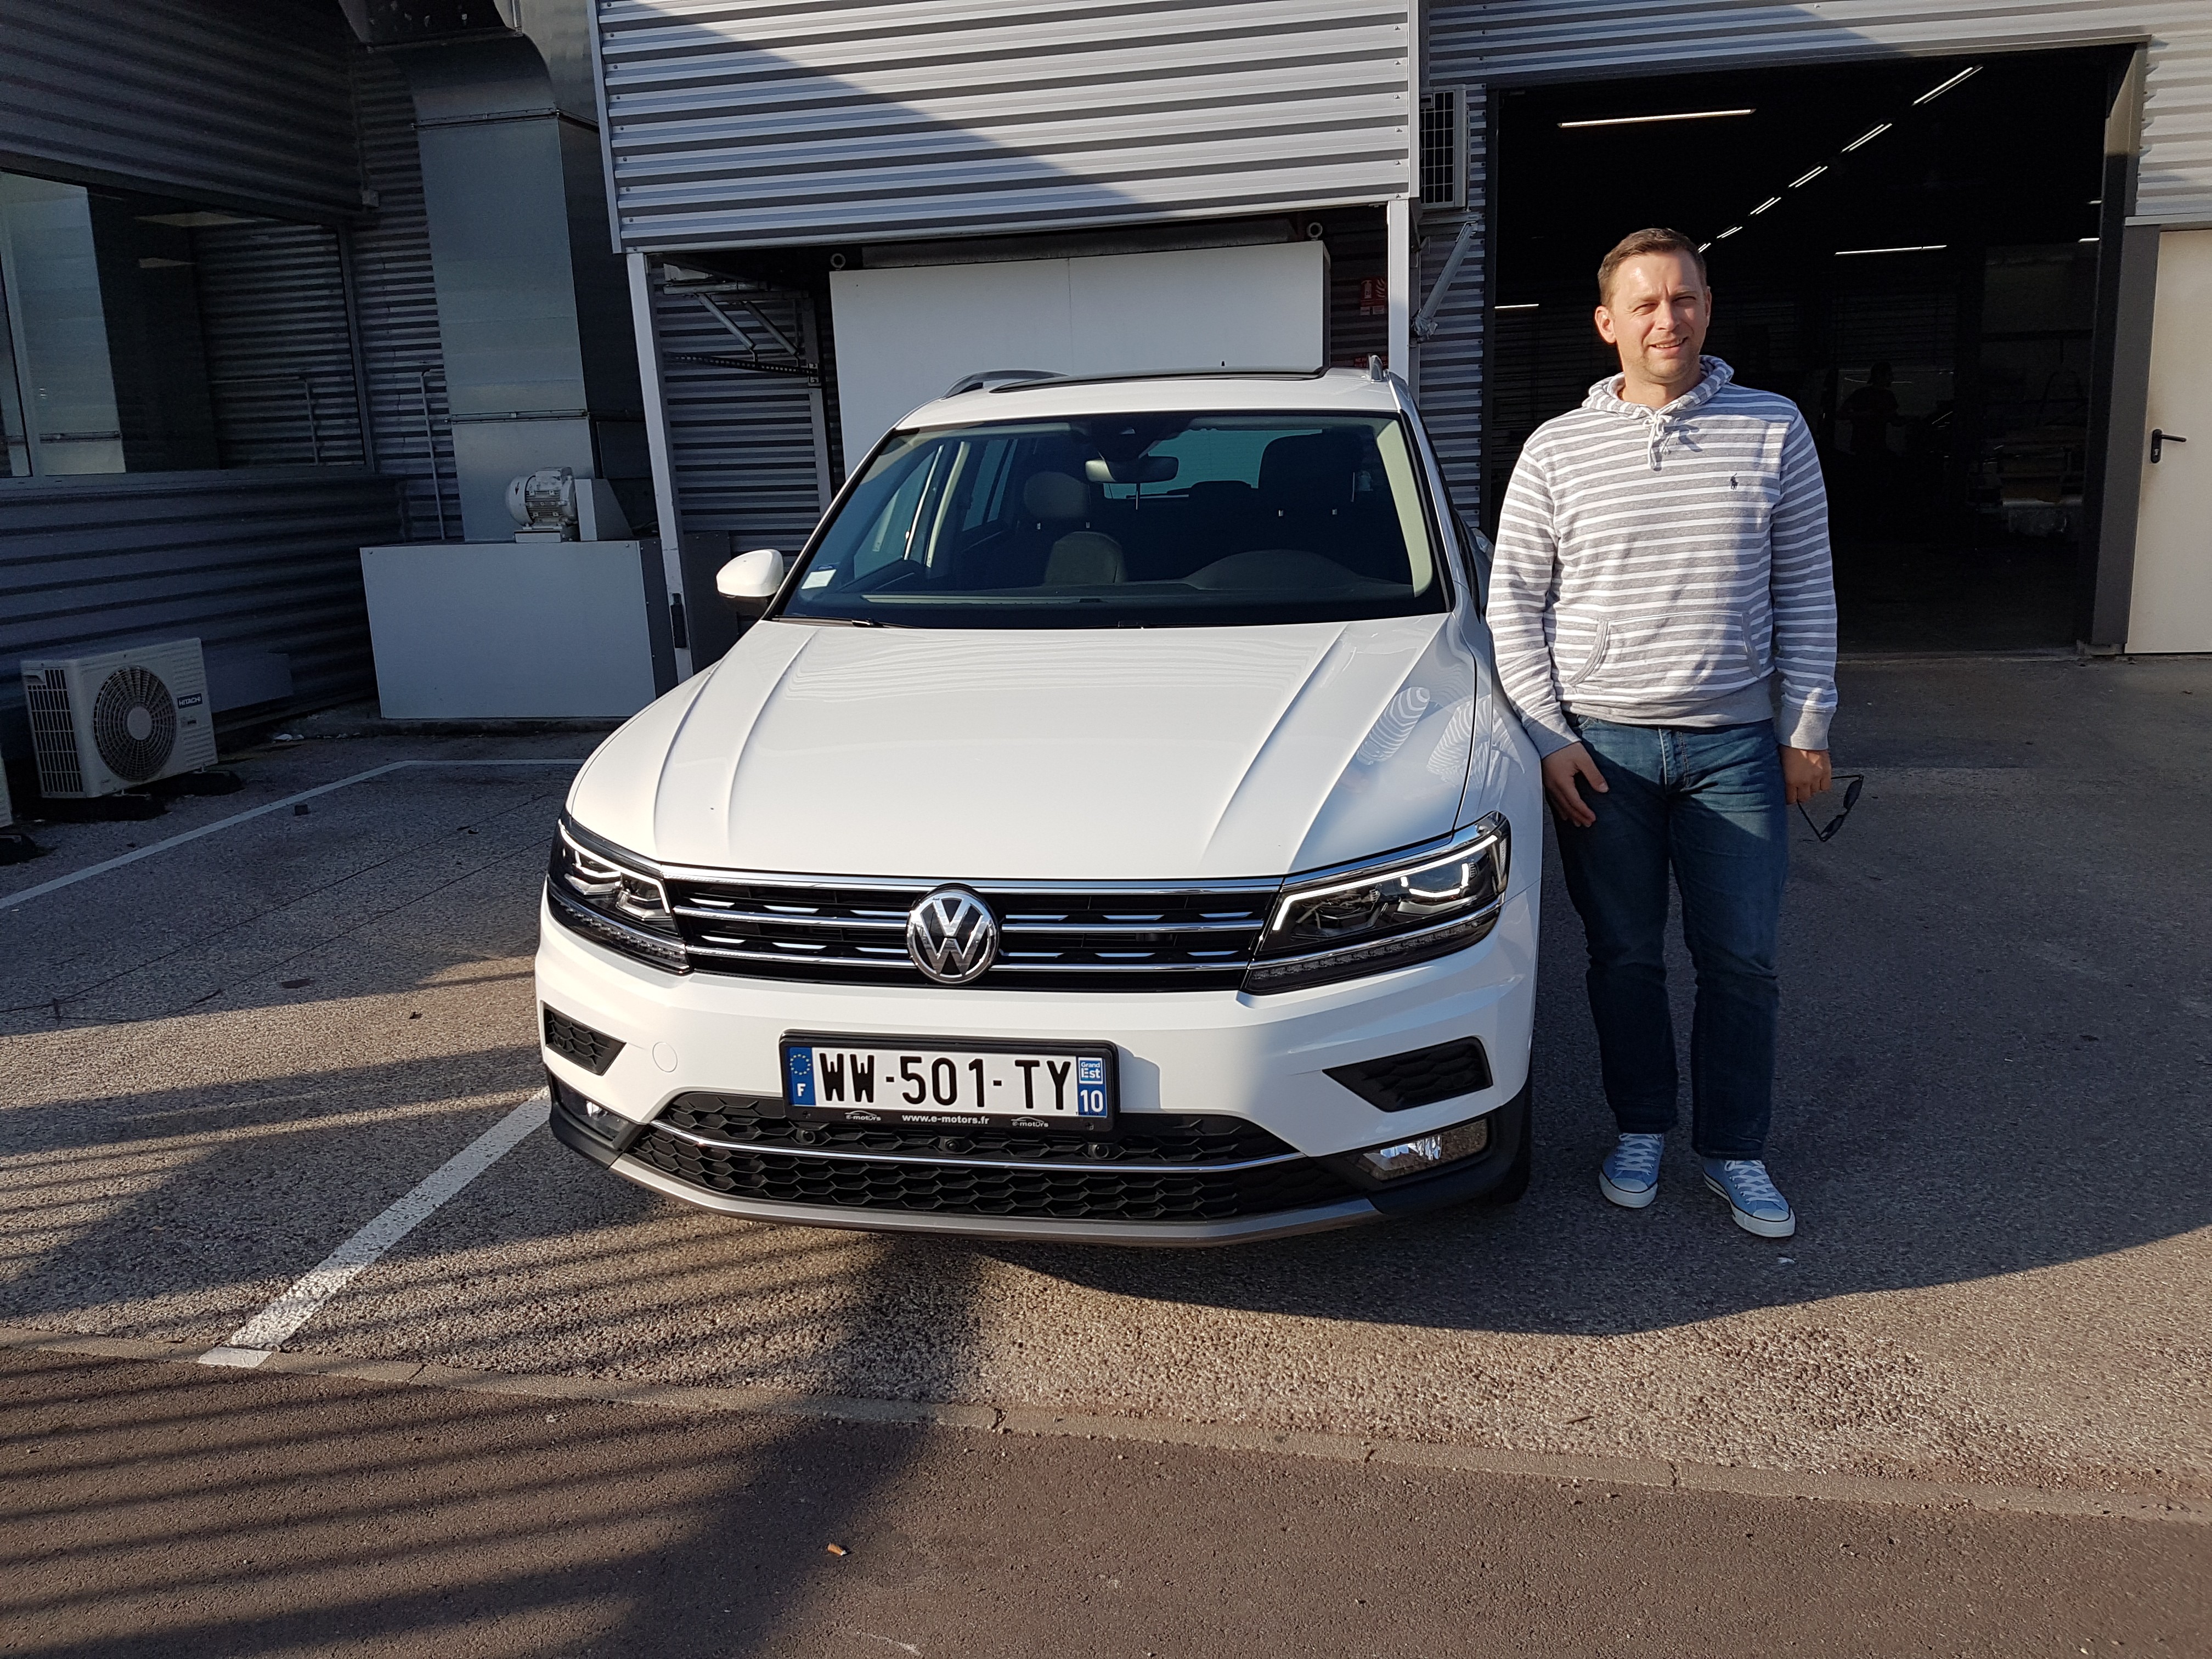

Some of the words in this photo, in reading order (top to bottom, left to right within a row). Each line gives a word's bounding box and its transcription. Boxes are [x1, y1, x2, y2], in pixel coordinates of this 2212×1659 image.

[179, 696, 201, 706] HITACHI
[1081, 1068, 1101, 1079] Est
[797, 1083, 806, 1097] F
[1080, 1089, 1103, 1113] 10
[901, 1114, 990, 1125] www.e-motors.fr
